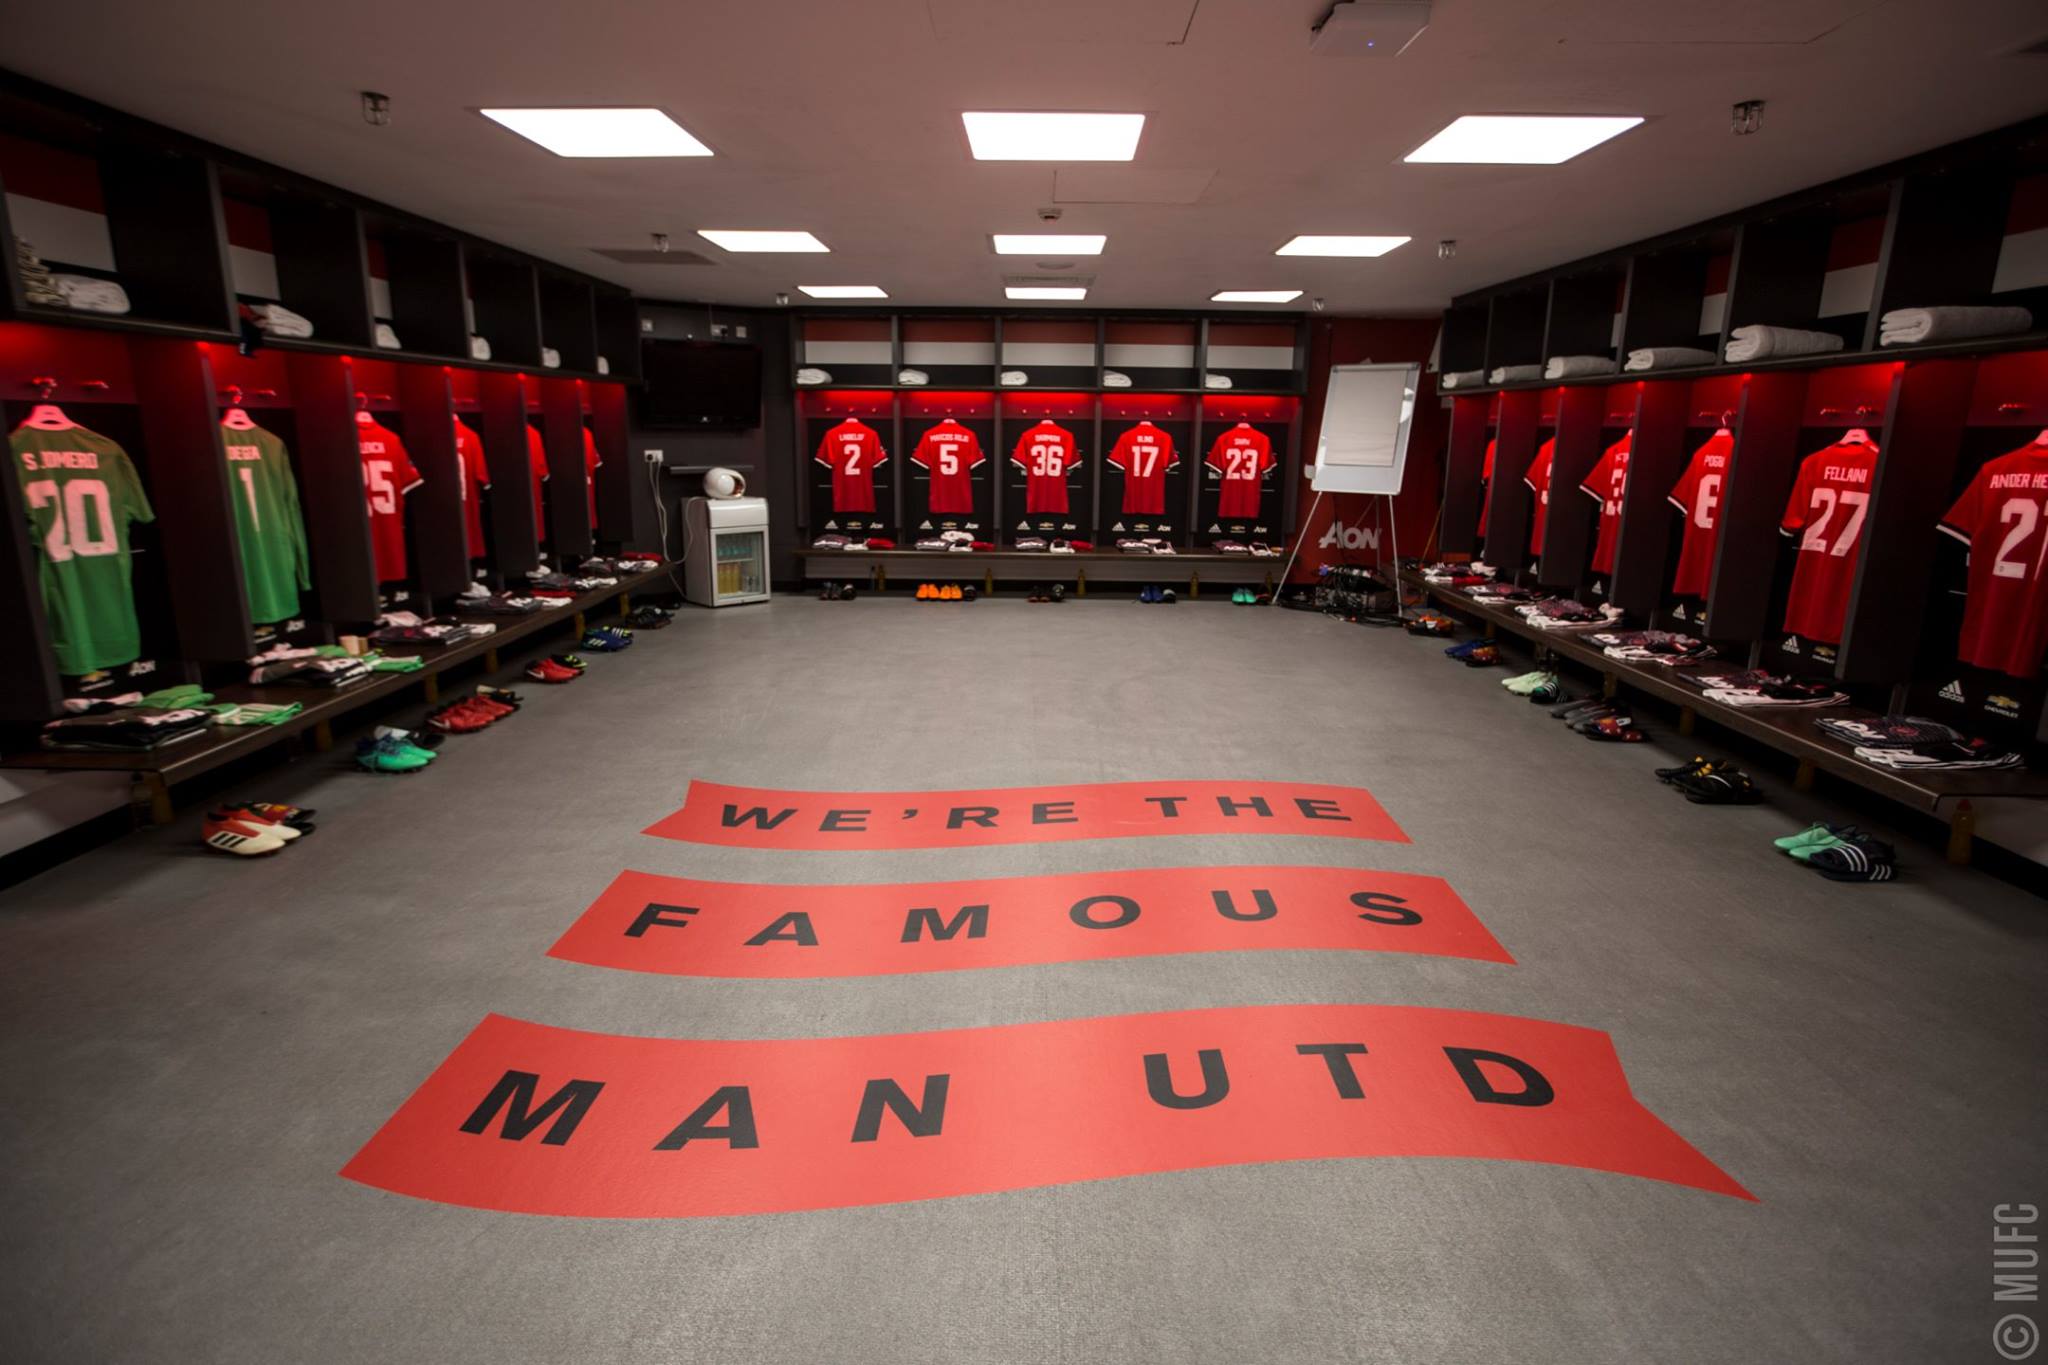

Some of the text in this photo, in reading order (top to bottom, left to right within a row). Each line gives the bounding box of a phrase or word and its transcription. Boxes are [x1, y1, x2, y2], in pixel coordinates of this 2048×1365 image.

[843, 443, 861, 476] 2
[939, 443, 959, 476] 5
[1030, 444, 1065, 477] 36
[1131, 445, 1160, 478] 17
[1225, 448, 1259, 480] 23
[1989, 473, 2031, 489] ANDER
[238, 467, 260, 532] 1
[26, 479, 119, 563] 20
[1801, 487, 1870, 557] 27
[1145, 795, 1352, 823] THE
[624, 889, 1423, 947] FAMOUS
[459, 1042, 1555, 1151] MAN UTD
